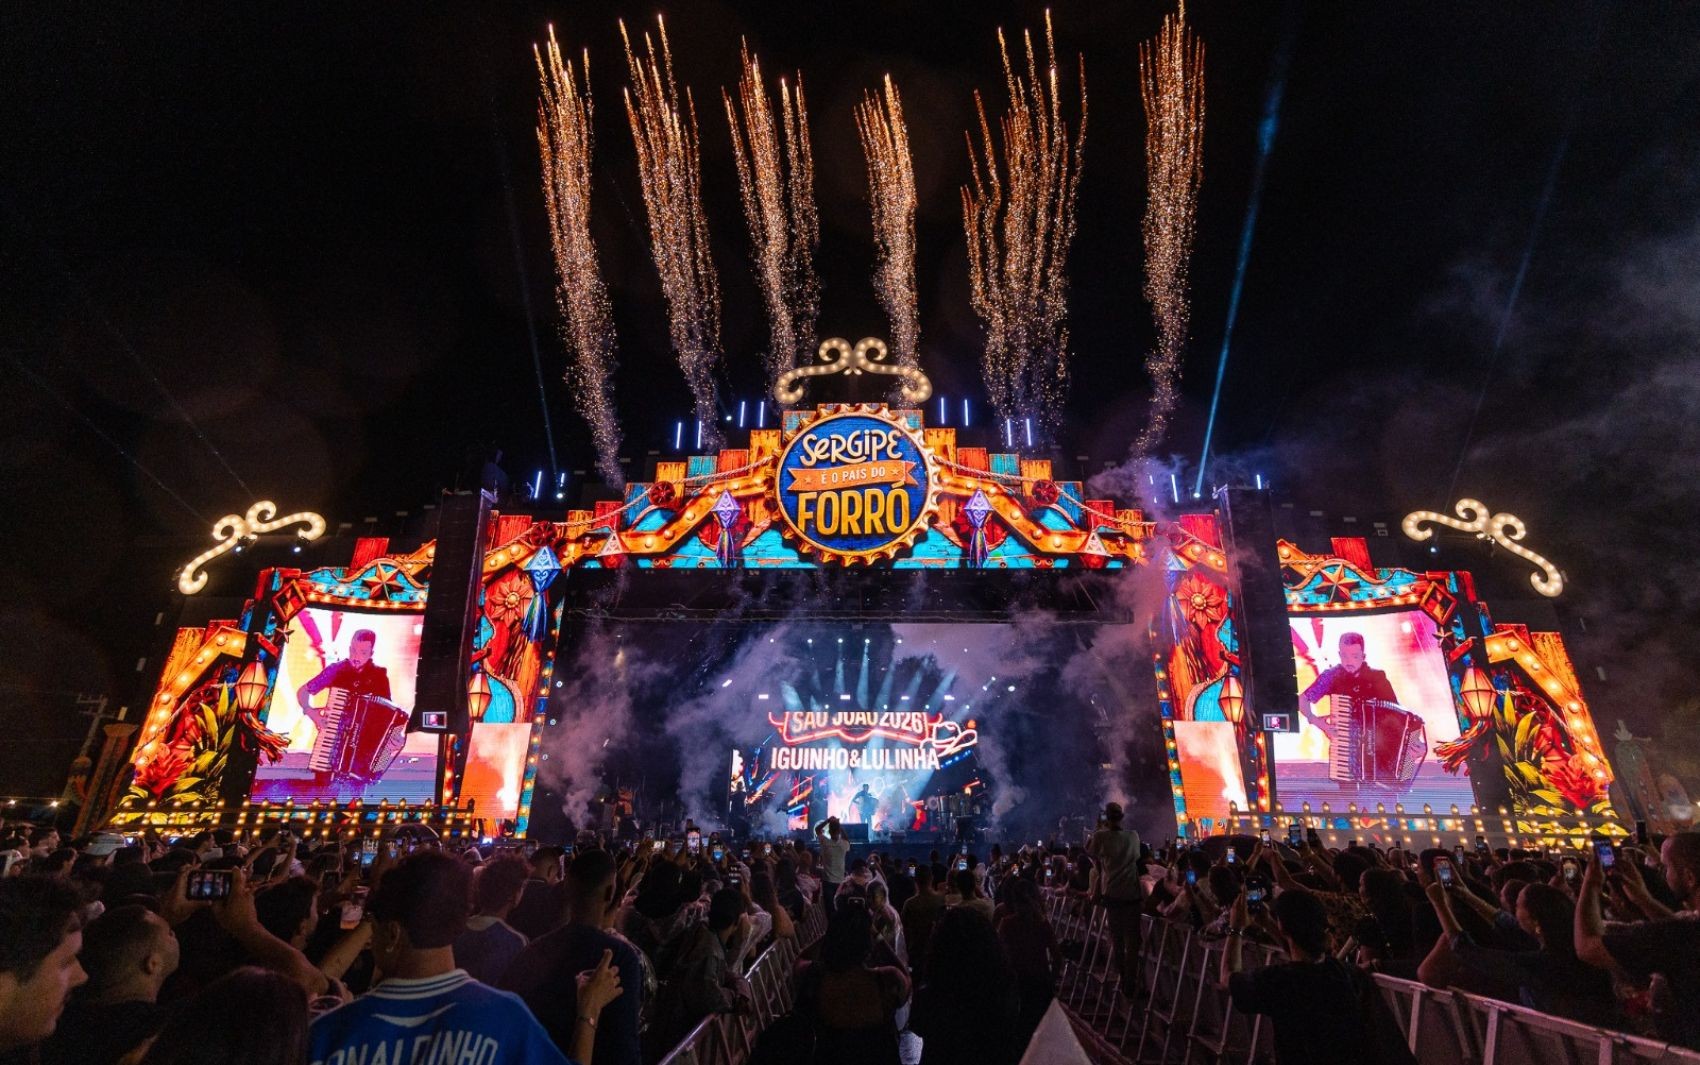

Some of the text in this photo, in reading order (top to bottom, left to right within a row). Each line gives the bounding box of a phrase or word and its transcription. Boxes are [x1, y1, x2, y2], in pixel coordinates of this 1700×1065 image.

[821, 467, 886, 484] É O PAÍS DO
[797, 481, 910, 535] FORRÓ
[879, 711, 924, 734] 2026
[310, 1030, 499, 1065] NALDINHO
